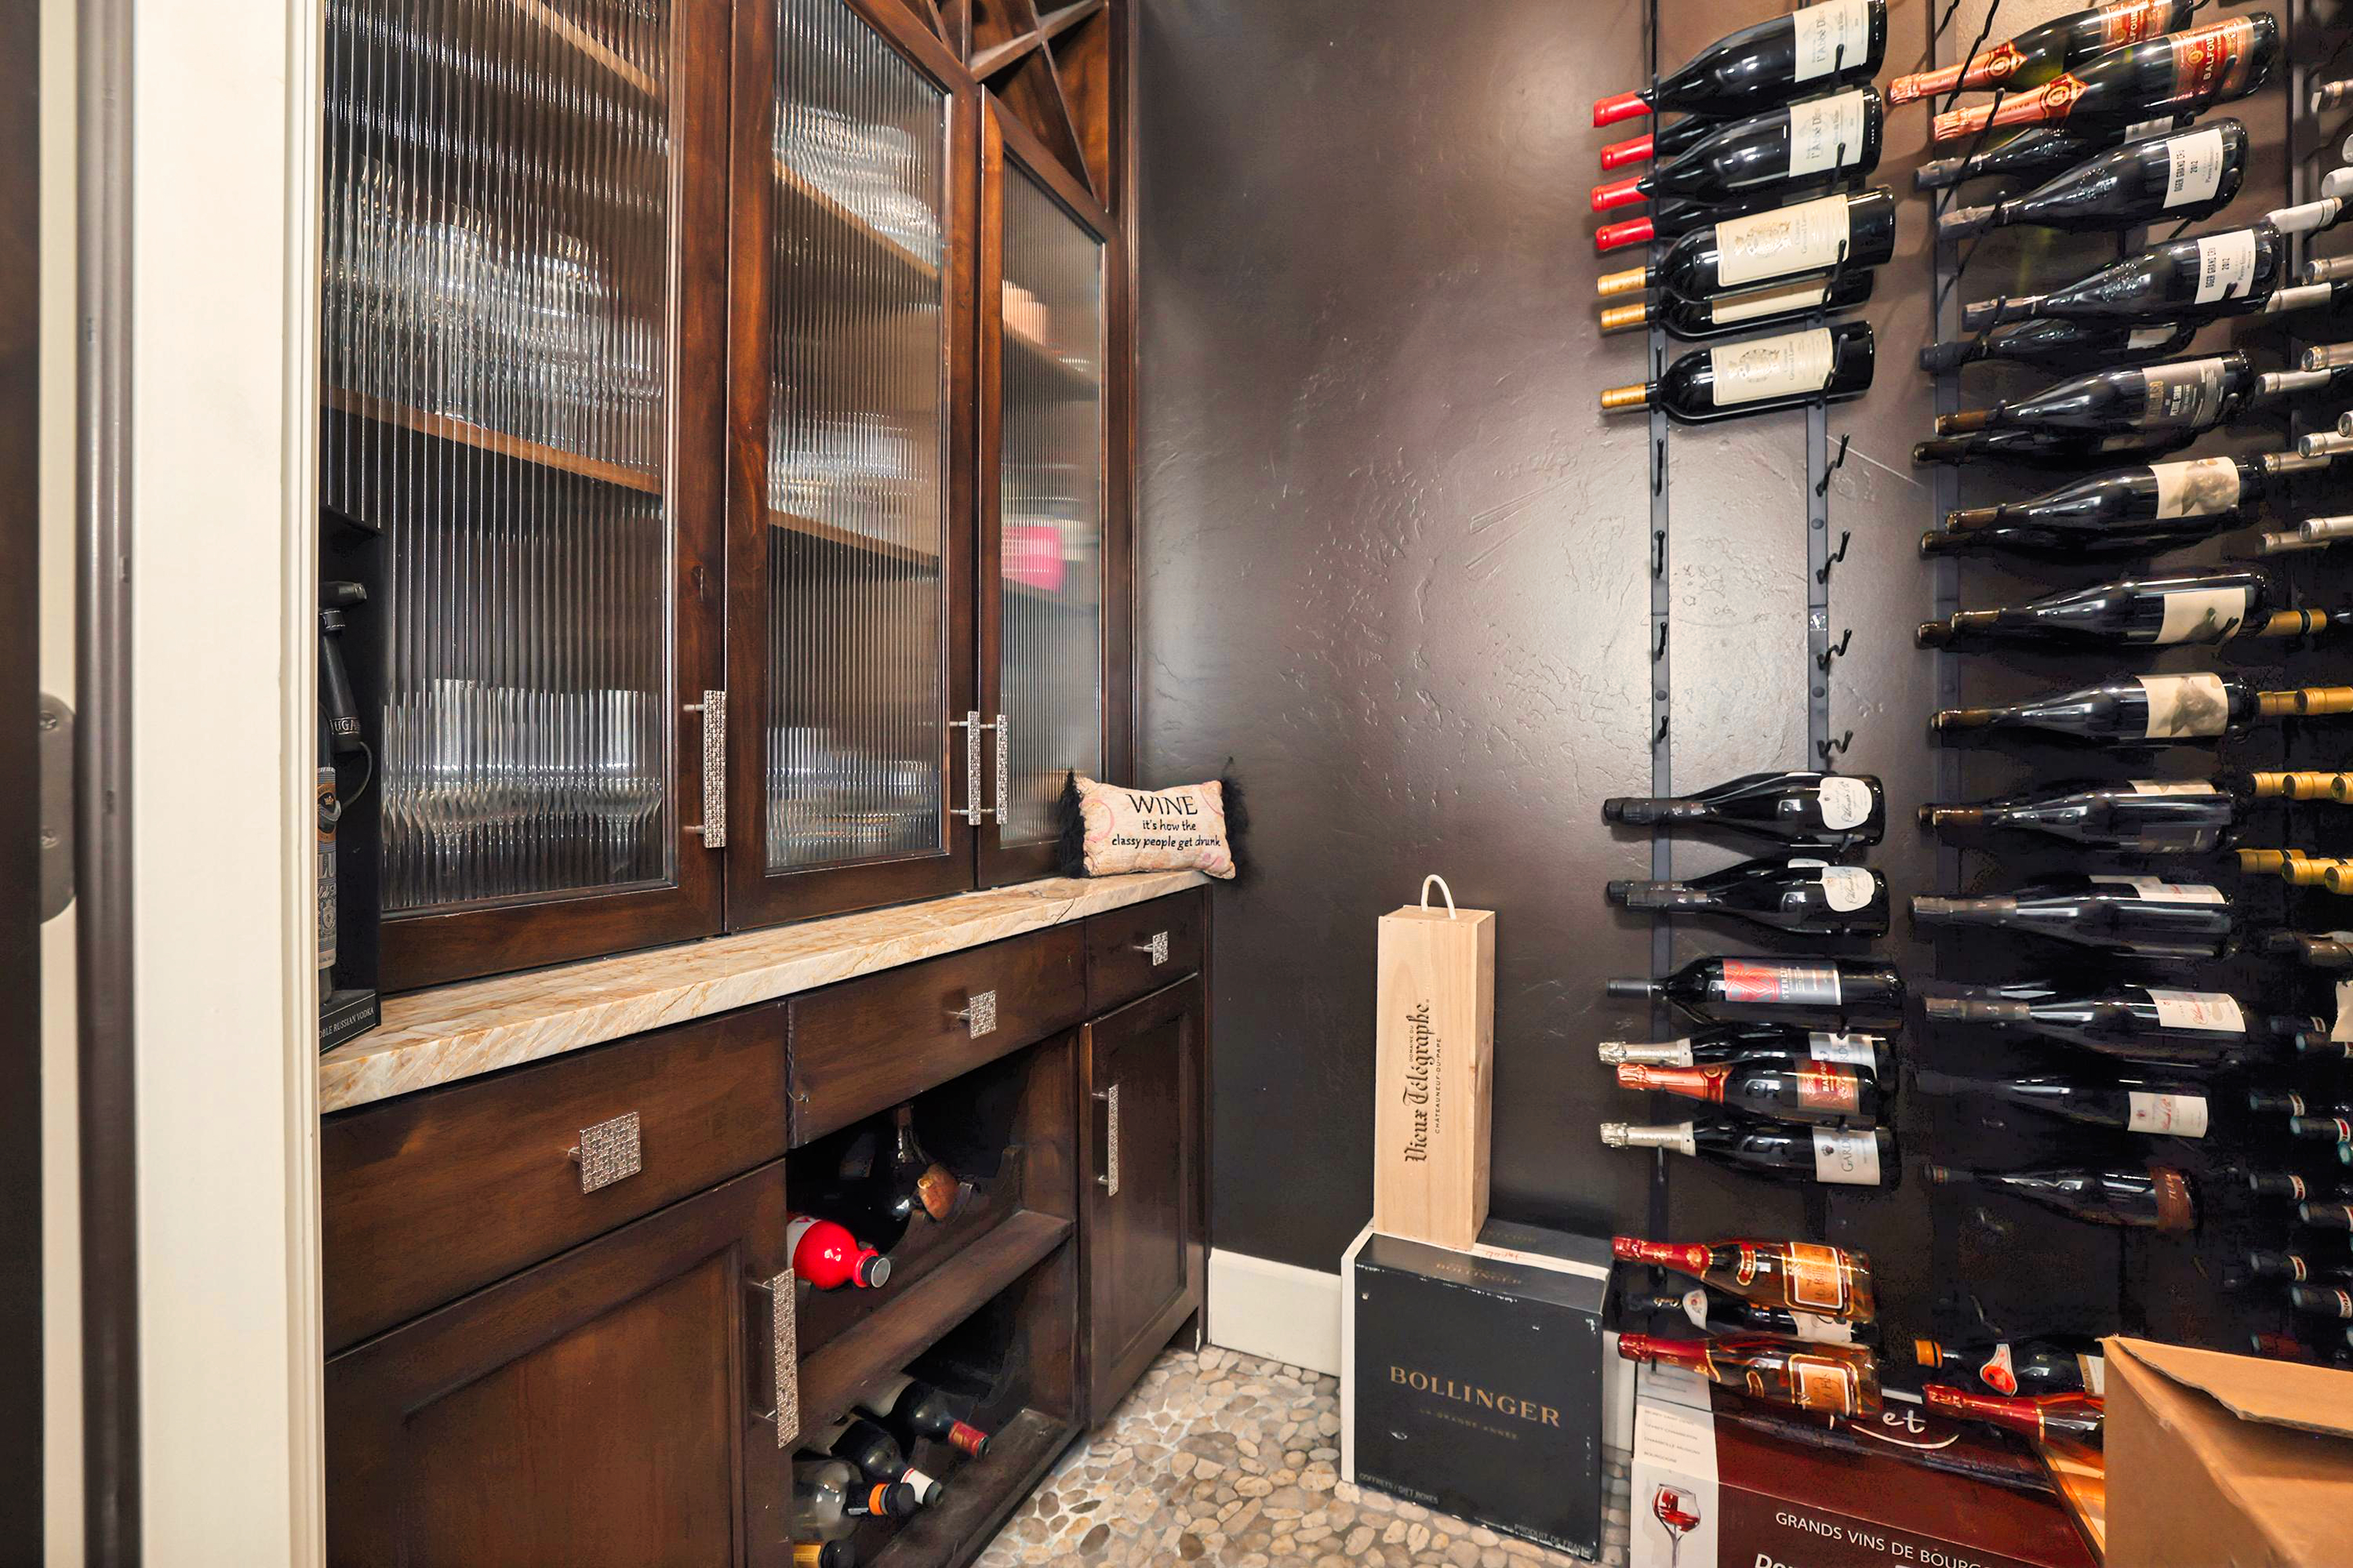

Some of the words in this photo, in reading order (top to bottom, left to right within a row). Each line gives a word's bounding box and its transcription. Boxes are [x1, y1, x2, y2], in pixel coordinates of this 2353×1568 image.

[2190, 160, 2198, 174] 2012
[2222, 258, 2230, 271] 2012
[1125, 793, 1198, 815] WINE
[1142, 819, 1157, 830] it's
[1159, 819, 1179, 830] how
[1182, 819, 1197, 830] the
[1112, 834, 1141, 849] classy
[1143, 836, 1176, 849] people
[1178, 839, 1193, 850] get
[1195, 835, 1221, 847] drunk
[334, 1015, 356, 1032] RUSSIAN
[357, 1006, 374, 1020] VODKA
[1402, 1003, 1435, 1106] Télégraphe
[1404, 1109, 1428, 1162] Vieux
[1390, 1366, 1560, 1428] BOLLINGER
[1514, 1524, 1548, 1540] PRODUIT
[1775, 1512, 1842, 1540] GRANDS
[1847, 1530, 1885, 1551] VINS
[1891, 1542, 1914, 1560] DE
